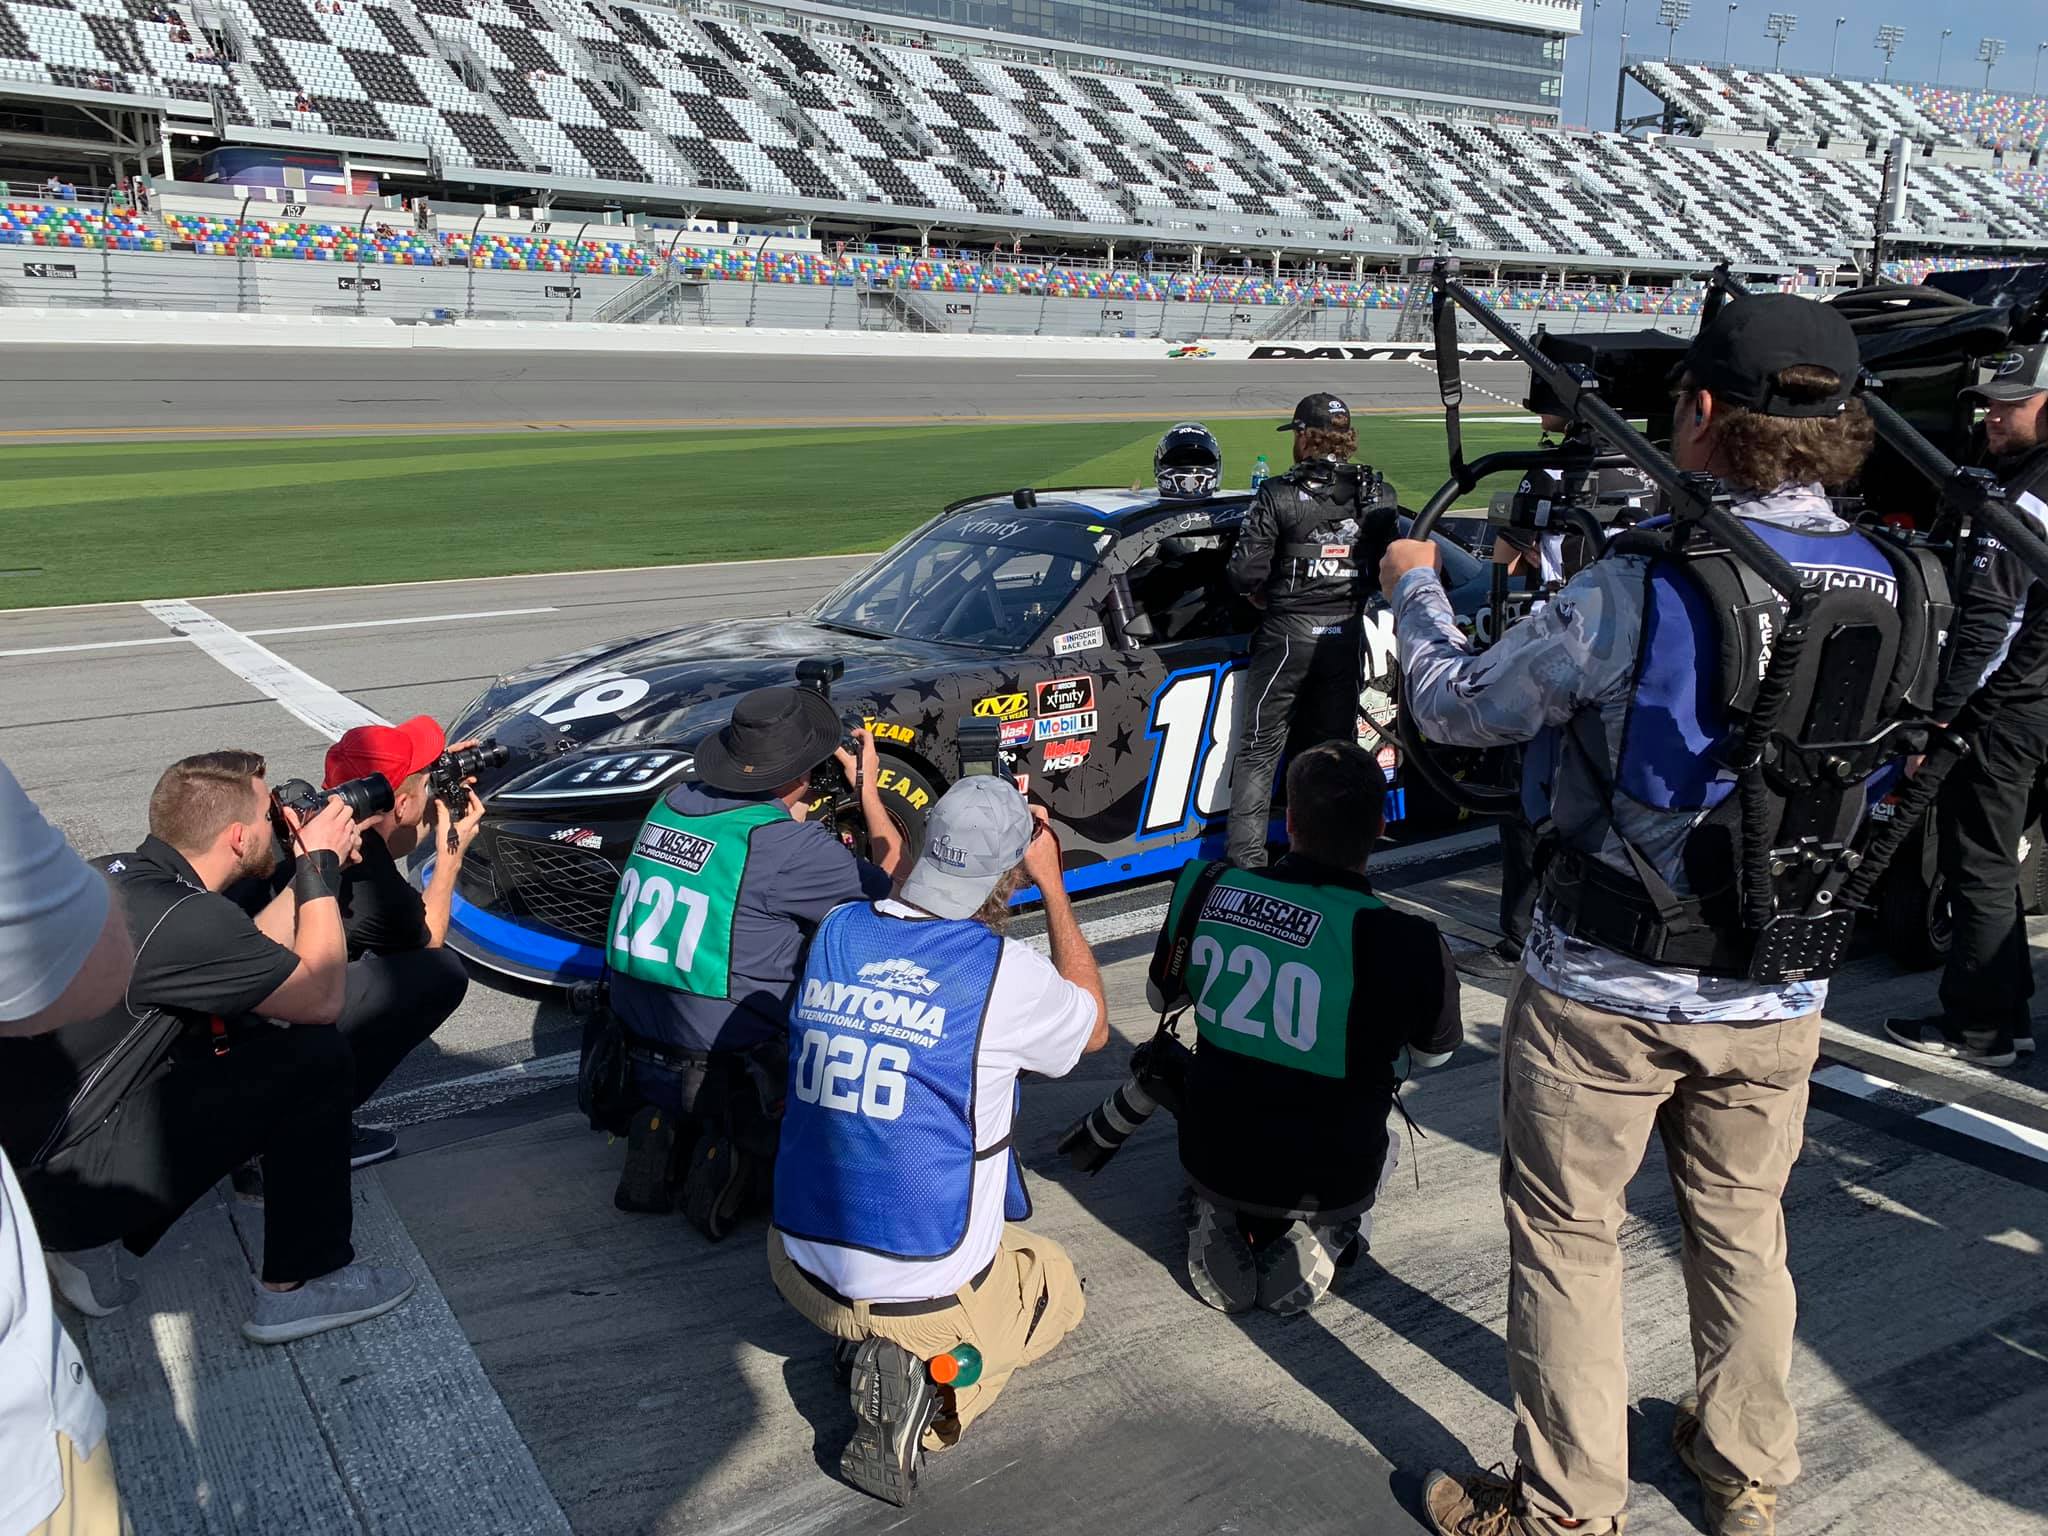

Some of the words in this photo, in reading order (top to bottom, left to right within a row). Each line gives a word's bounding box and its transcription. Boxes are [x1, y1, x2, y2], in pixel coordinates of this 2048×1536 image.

[286, 206, 301, 217] 152
[1247, 346, 1521, 361] DAYTON
[955, 515, 1029, 541] xfinity
[1061, 642, 1081, 651] RACE
[1082, 639, 1097, 647] CAR
[1069, 630, 1097, 642] NASCAR
[1046, 690, 1085, 708] xfinity
[1039, 717, 1077, 735] Mobil
[1081, 714, 1092, 728] 1
[1043, 739, 1091, 760] Holley
[1043, 754, 1084, 772] MSD
[877, 769, 929, 811] EAR
[645, 848, 700, 871] PRODUCTIONS
[657, 830, 708, 862] NASCAR
[612, 867, 710, 973] 227
[1225, 912, 1307, 944] PRODUCTIONS
[1238, 893, 1316, 936] NASCAR
[1170, 936, 1188, 977] Canon
[802, 978, 946, 1037] DAYTONA
[1191, 935, 1322, 1052] 220
[798, 1008, 866, 1031] INTERNATIONAL
[869, 1023, 939, 1049] SPEEDWAY
[795, 1028, 911, 1121] 026
